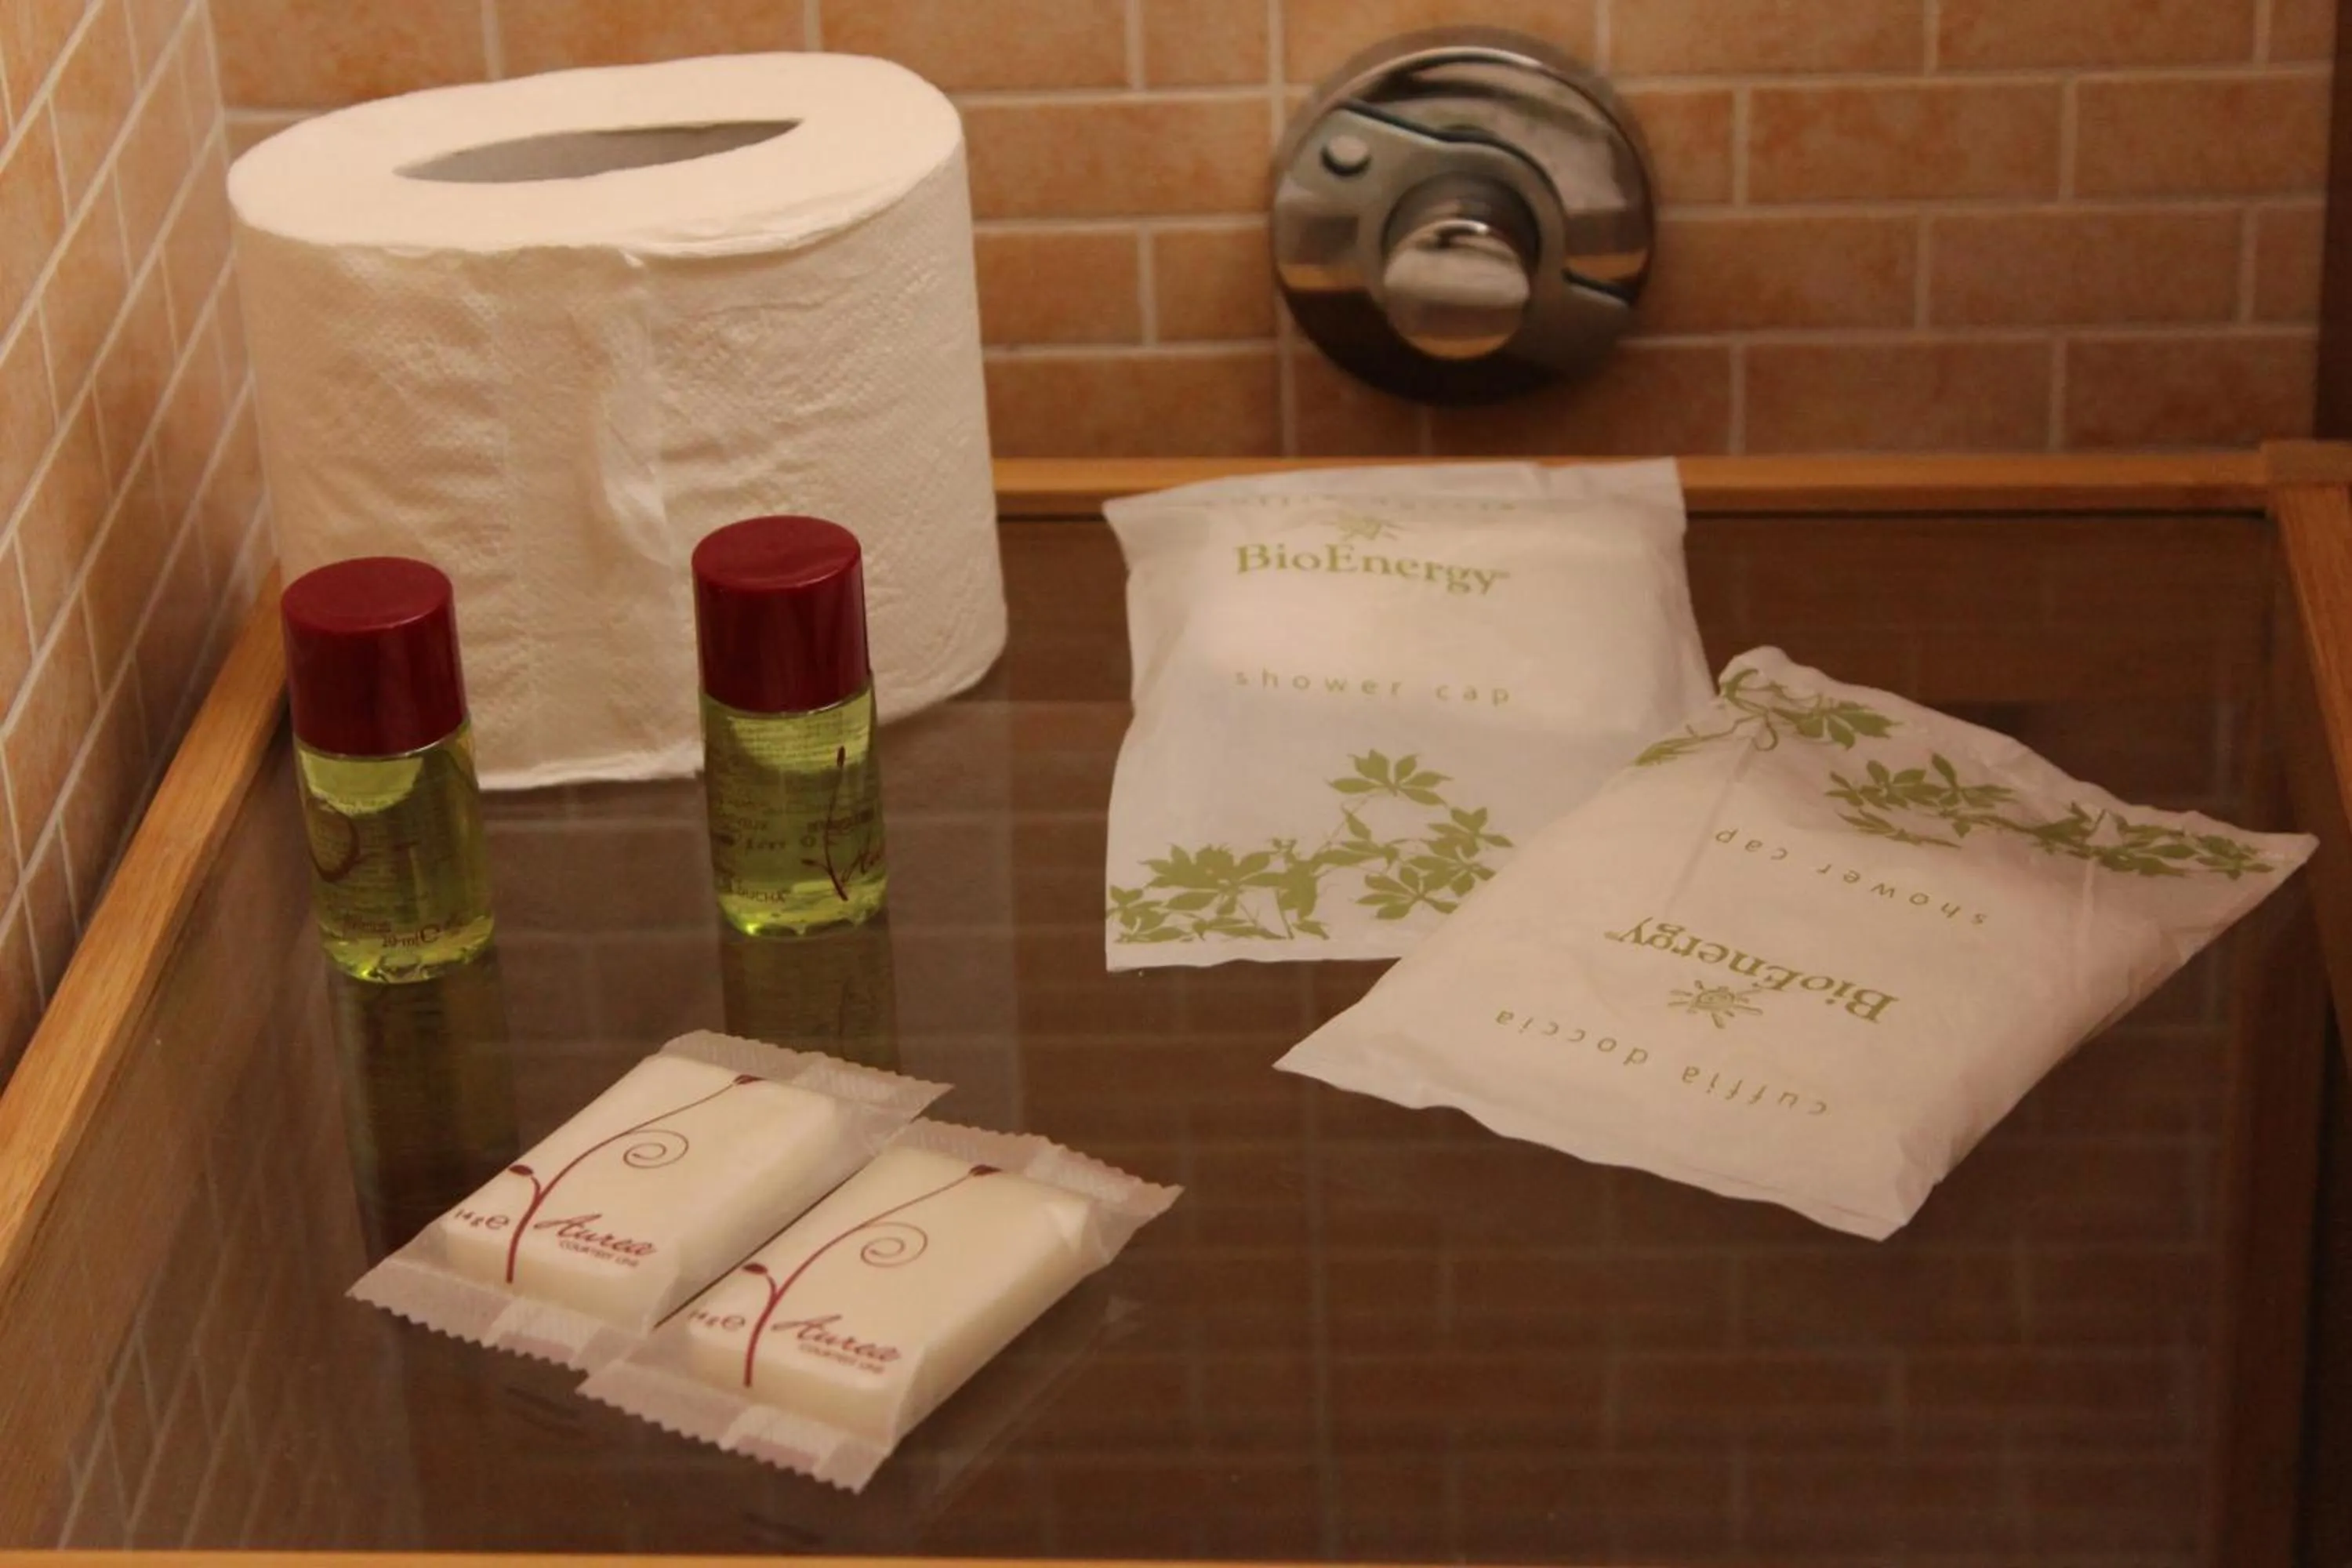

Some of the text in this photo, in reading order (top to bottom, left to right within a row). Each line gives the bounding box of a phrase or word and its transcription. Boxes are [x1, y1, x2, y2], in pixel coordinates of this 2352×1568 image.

[1234, 543, 1501, 594] BioEnergy
[1234, 667, 1510, 706] shower cap
[1715, 828, 1988, 926] shower cap
[1613, 916, 1900, 1025] BioEnergy
[1494, 1010, 1828, 1117] cuffia doccia
